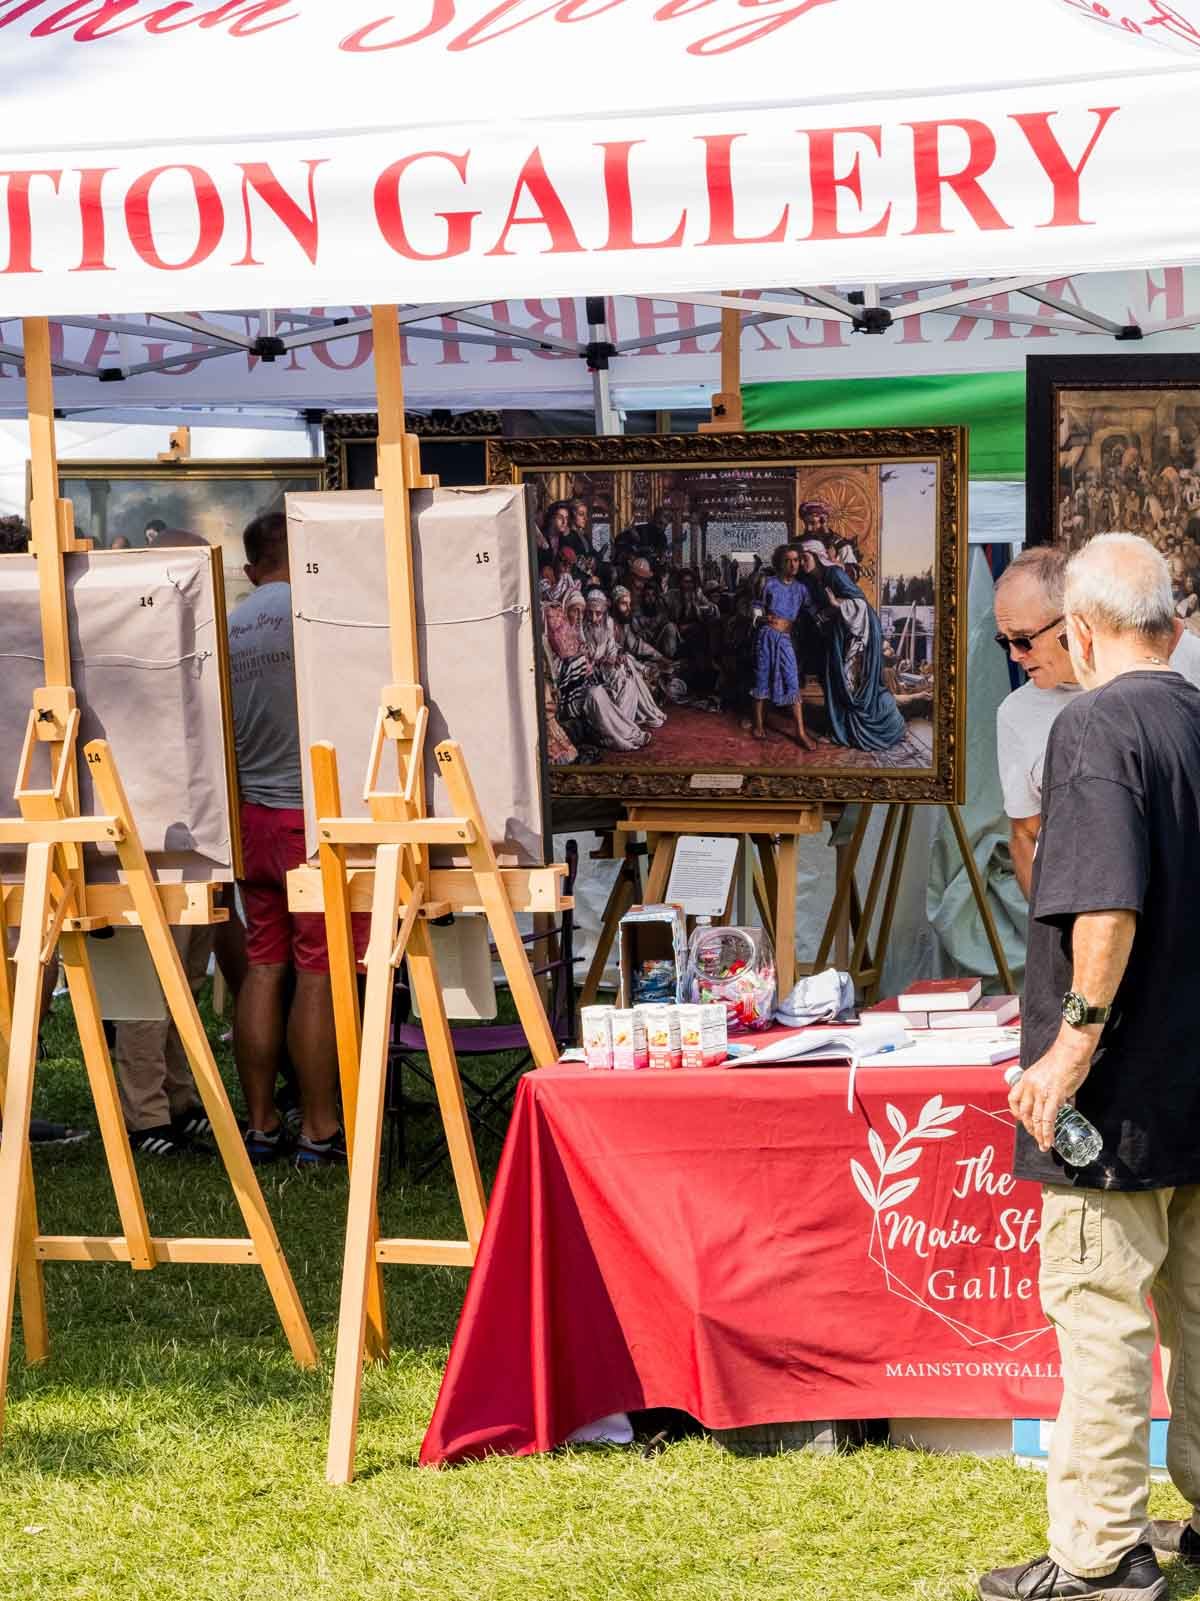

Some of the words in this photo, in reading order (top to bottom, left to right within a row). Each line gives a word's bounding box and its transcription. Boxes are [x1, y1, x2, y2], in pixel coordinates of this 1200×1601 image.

[373, 106, 1120, 261] GALLERY
[475, 552, 490, 564] 15
[306, 563, 319, 574] 15
[140, 597, 154, 608] 14
[87, 752, 102, 765] 14
[437, 750, 452, 764] 15
[953, 1145, 1016, 1199] The
[884, 1210, 982, 1258] Main
[994, 1208, 1042, 1253] St
[927, 1266, 1040, 1301] Galle
